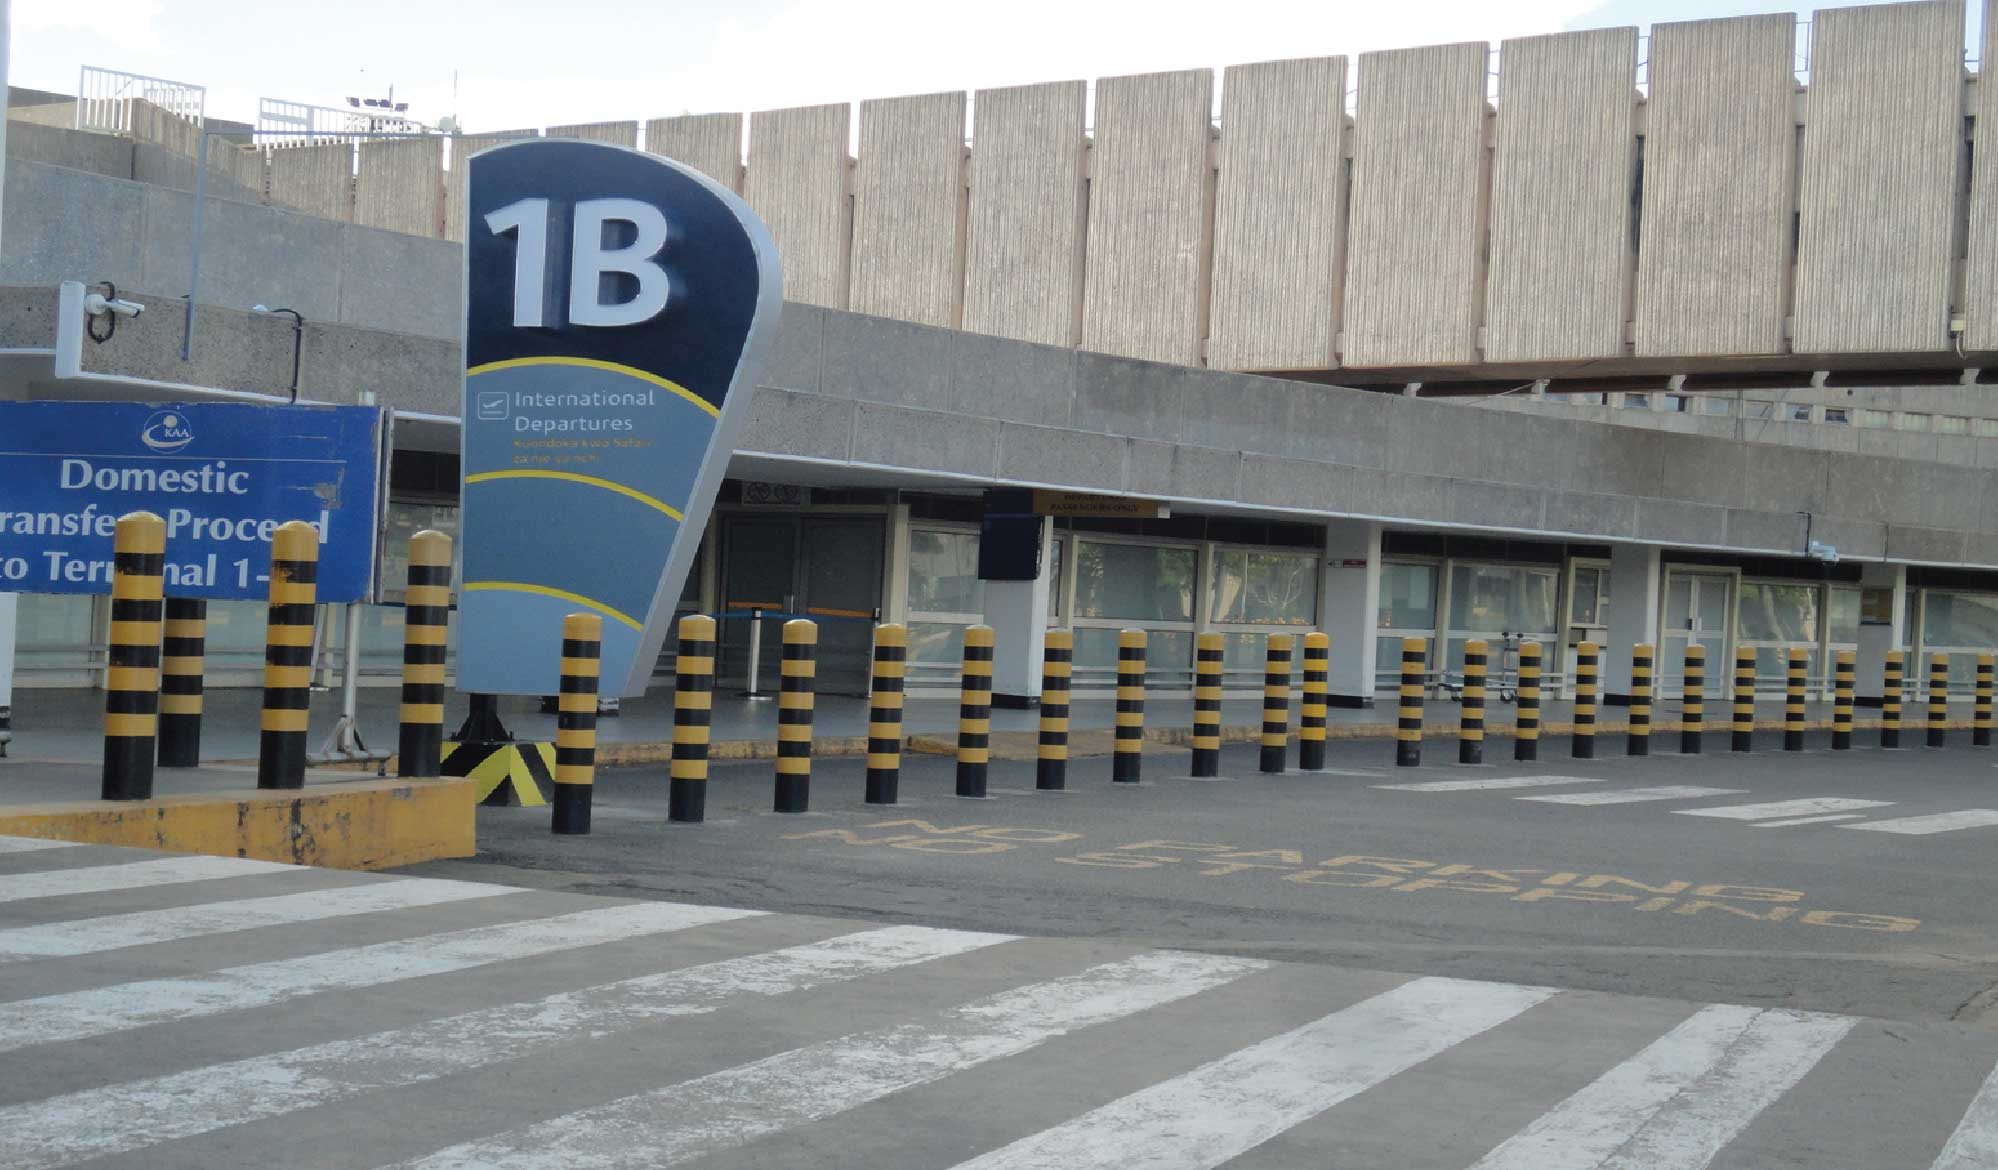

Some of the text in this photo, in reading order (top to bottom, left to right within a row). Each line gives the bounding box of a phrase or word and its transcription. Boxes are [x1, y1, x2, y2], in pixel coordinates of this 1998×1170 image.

[484, 197, 669, 327] 1B
[514, 388, 656, 407] International
[164, 427, 189, 438] KAA
[514, 415, 633, 436] Departures
[60, 458, 250, 495] Domestic
[0, 503, 329, 544] ransfe Proced
[43, 551, 217, 587] Ternal
[864, 819, 1806, 903] NO PARKING
[779, 828, 1922, 934] NO STOPPING
